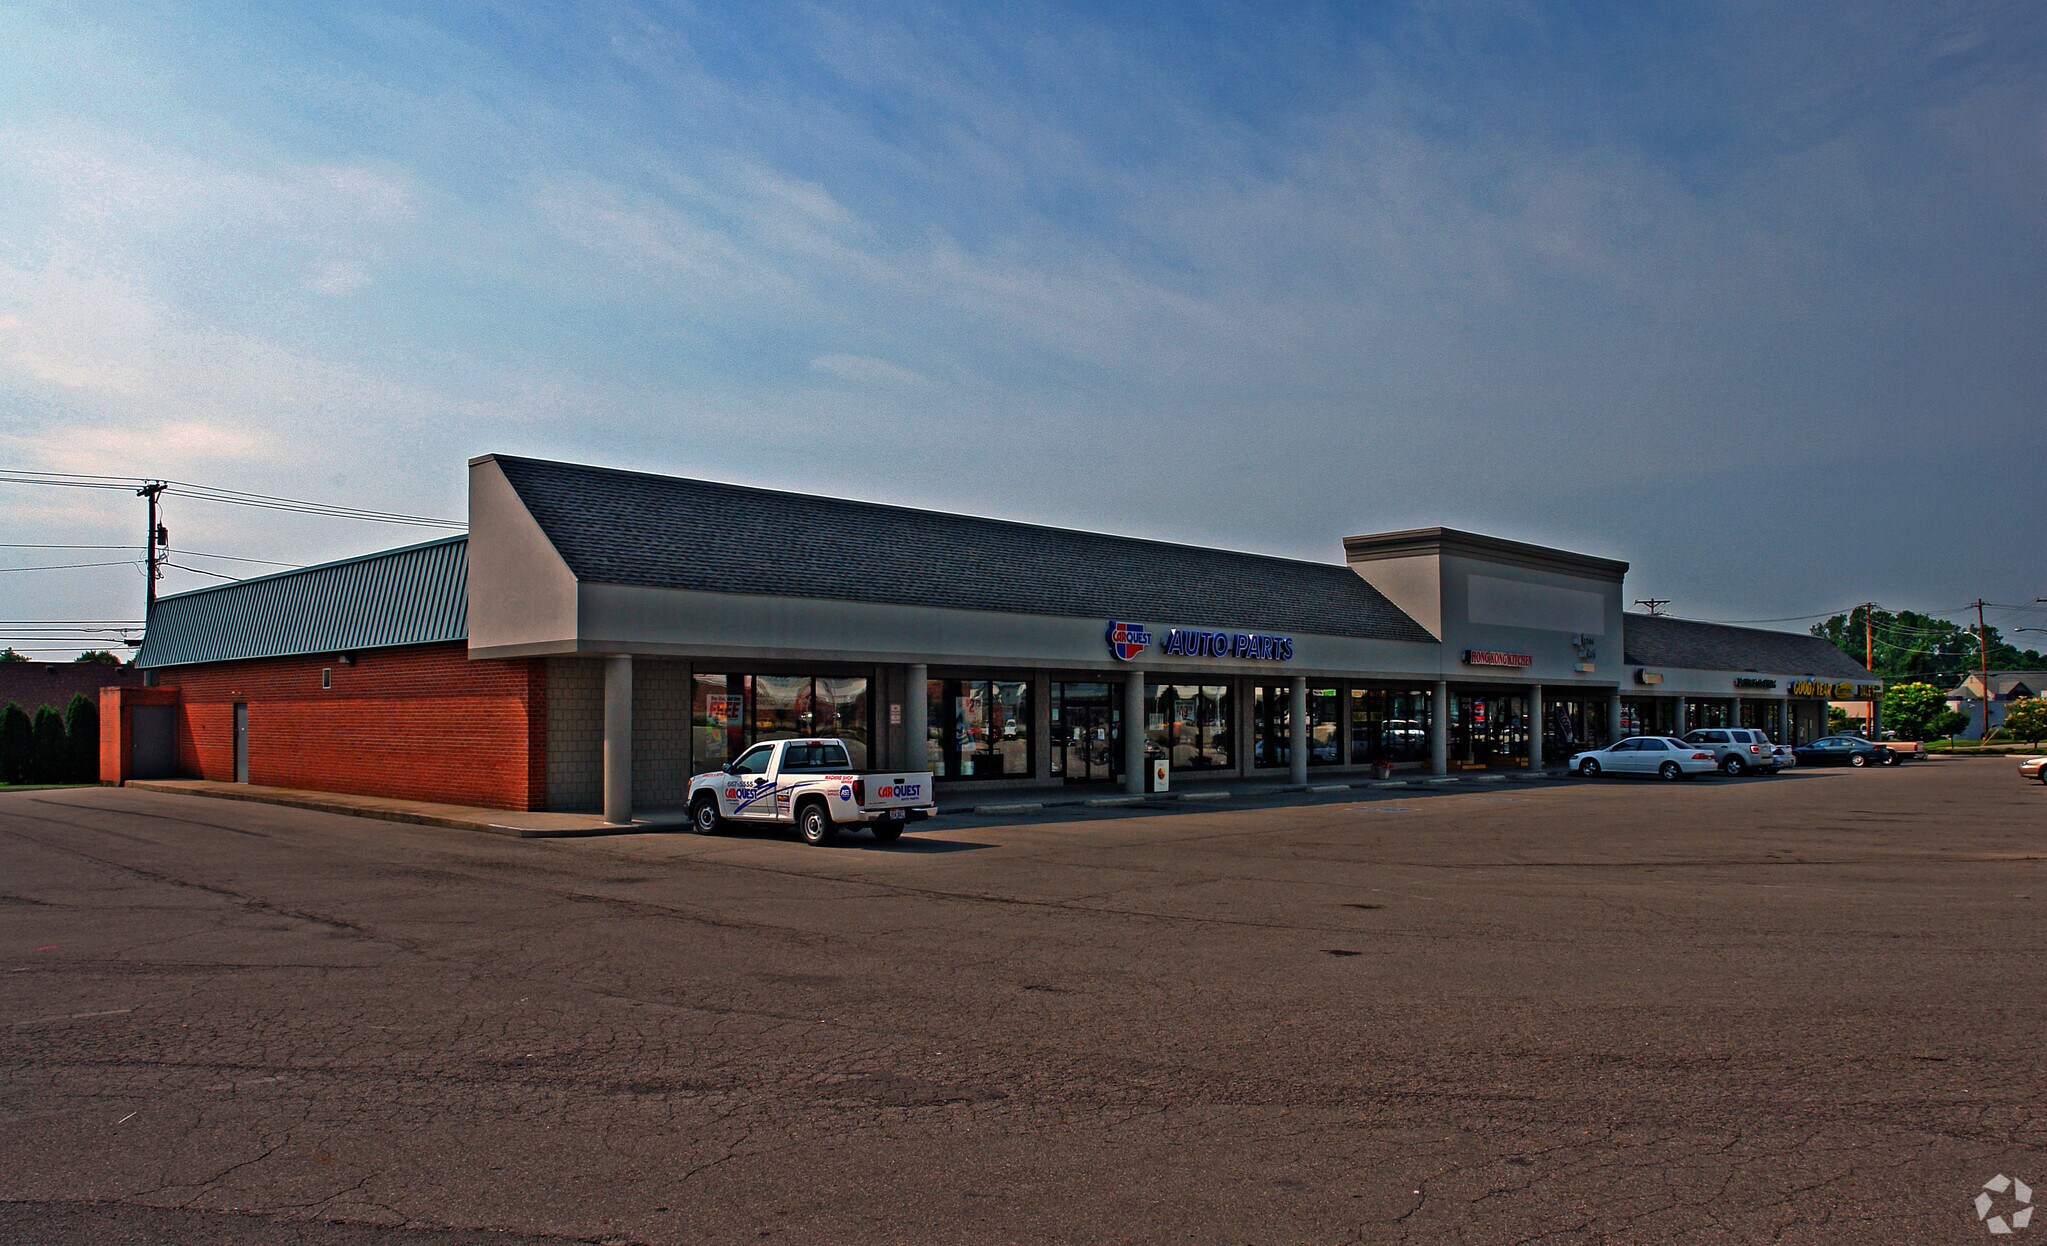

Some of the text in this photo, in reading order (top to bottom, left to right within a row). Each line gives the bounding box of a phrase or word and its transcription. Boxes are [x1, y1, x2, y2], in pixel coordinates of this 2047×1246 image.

[1112, 630, 1152, 644] CARQUEST
[1166, 630, 1293, 660] AUTO PARTS
[1471, 651, 1533, 667] HONG KONG KITCHEN
[1793, 680, 1832, 697] GOODYEAR
[708, 701, 741, 718] FREE
[725, 788, 758, 799] CARQUEST
[878, 785, 921, 798] CARQUEST
